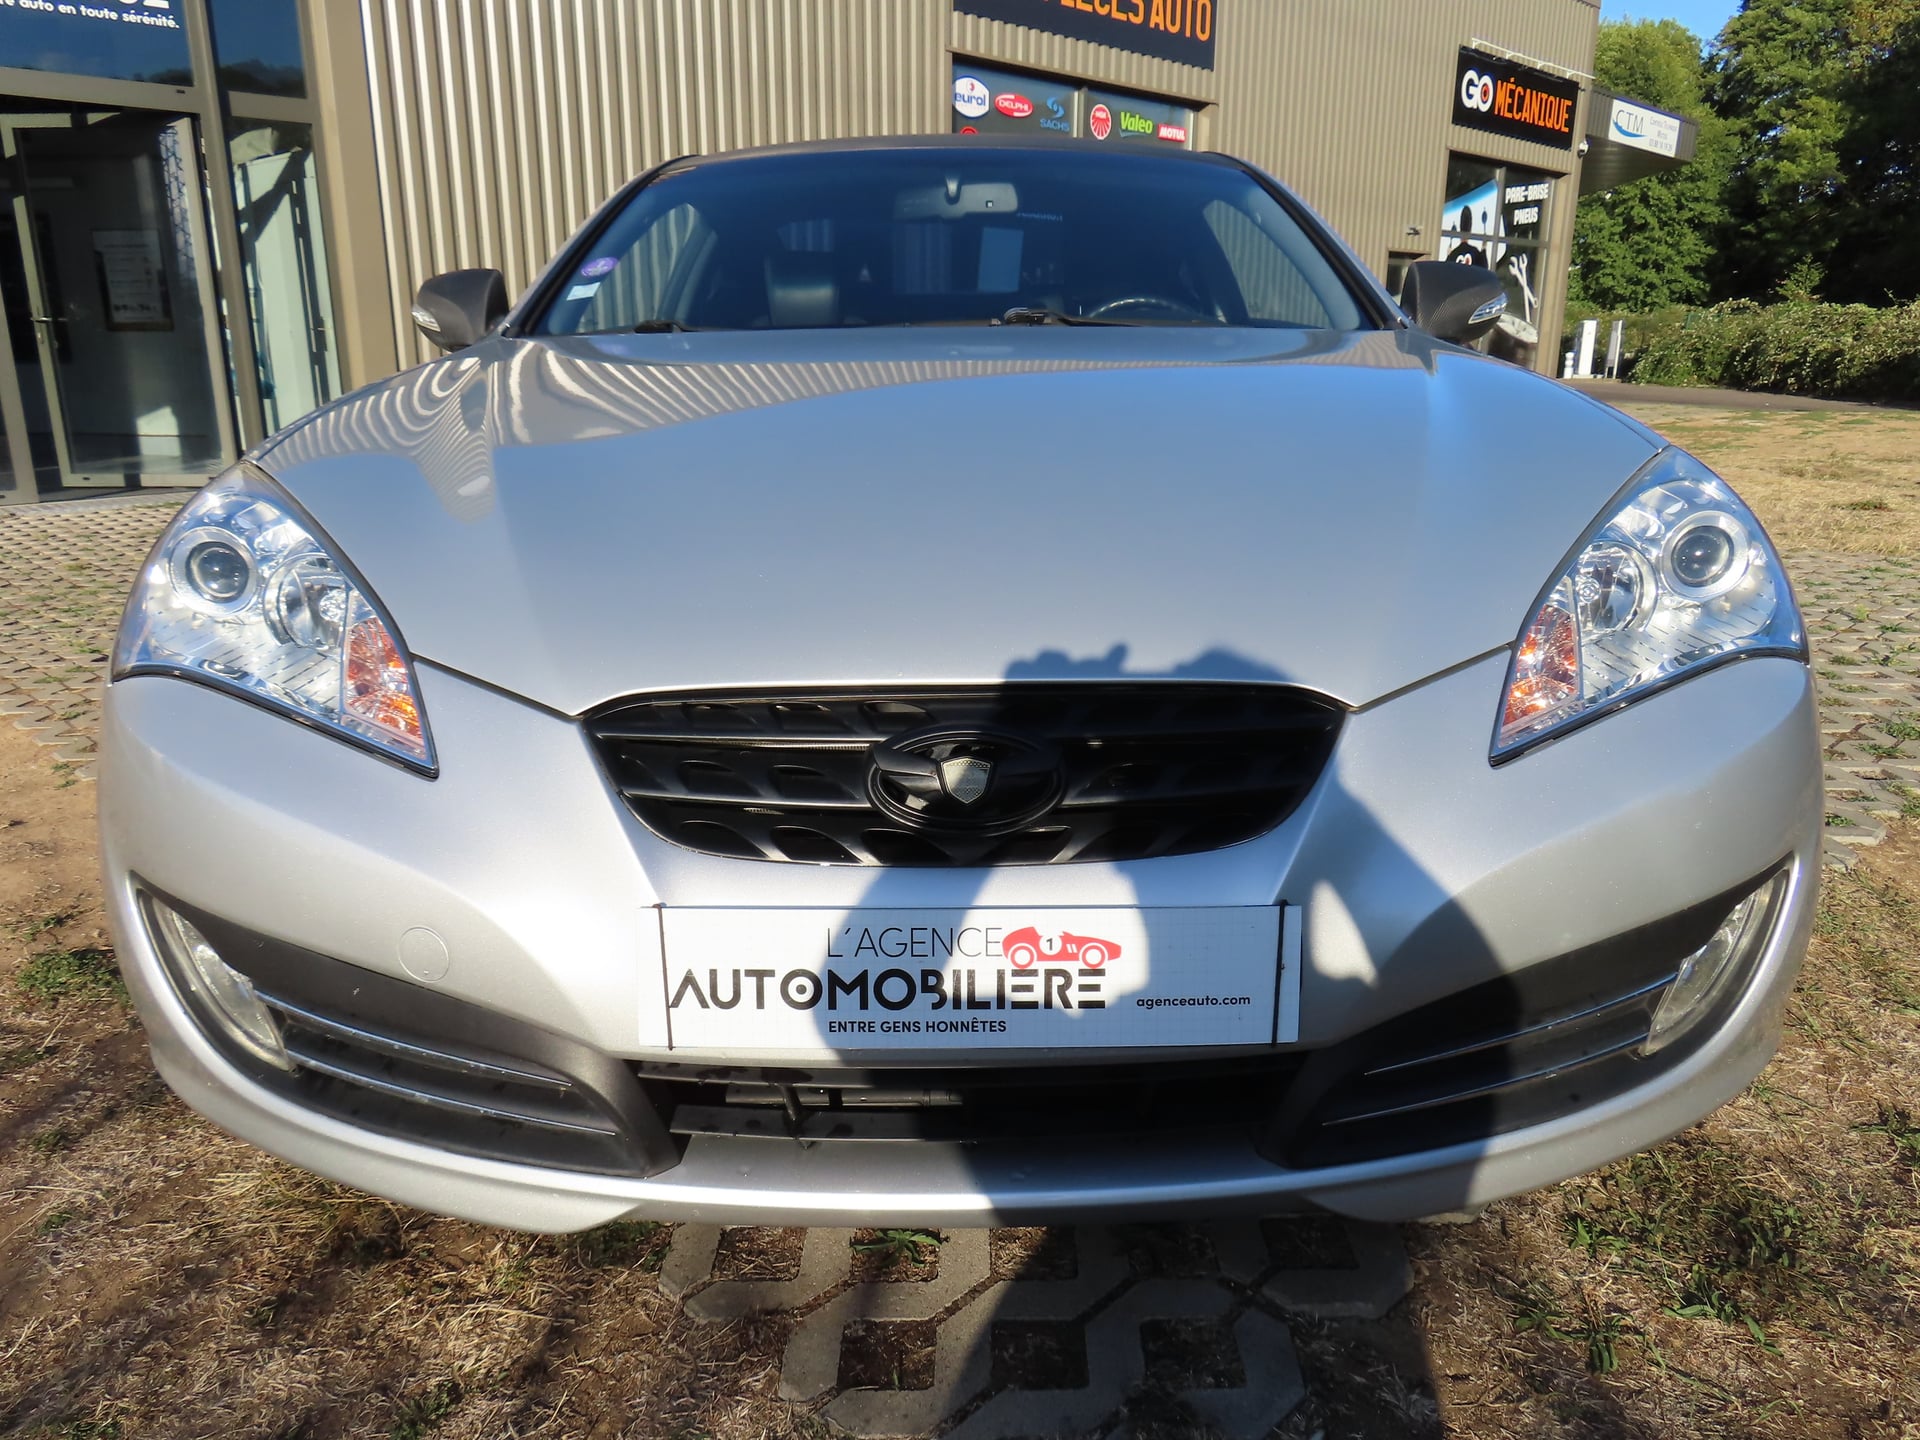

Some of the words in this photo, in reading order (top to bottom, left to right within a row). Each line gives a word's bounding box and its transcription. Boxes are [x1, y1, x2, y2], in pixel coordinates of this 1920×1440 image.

[19, 0, 54, 11] auto
[58, 4, 77, 15] en
[80, 6, 119, 20] toute
[122, 10, 180, 29] sérénité.
[1150, 0, 1212, 41] AUTO
[954, 92, 986, 107] eurol
[998, 99, 1029, 112] DELPHI
[1461, 69, 1494, 113] GO
[1494, 77, 1573, 133] MÉCANIQUE
[1040, 118, 1070, 133] SACHS
[1120, 111, 1154, 134] Valeo
[1615, 109, 1644, 133] CTM
[1159, 126, 1186, 140] MOTUL
[1513, 206, 1539, 226] PNEUS
[669, 968, 1106, 1011] AUTOMOBILIERE
[1136, 995, 1251, 1010] agenceauto.com
[829, 1020, 876, 1033] ENTRE
[883, 1020, 921, 1033] GENS
[925, 1017, 1007, 1033] HONNÊTES
